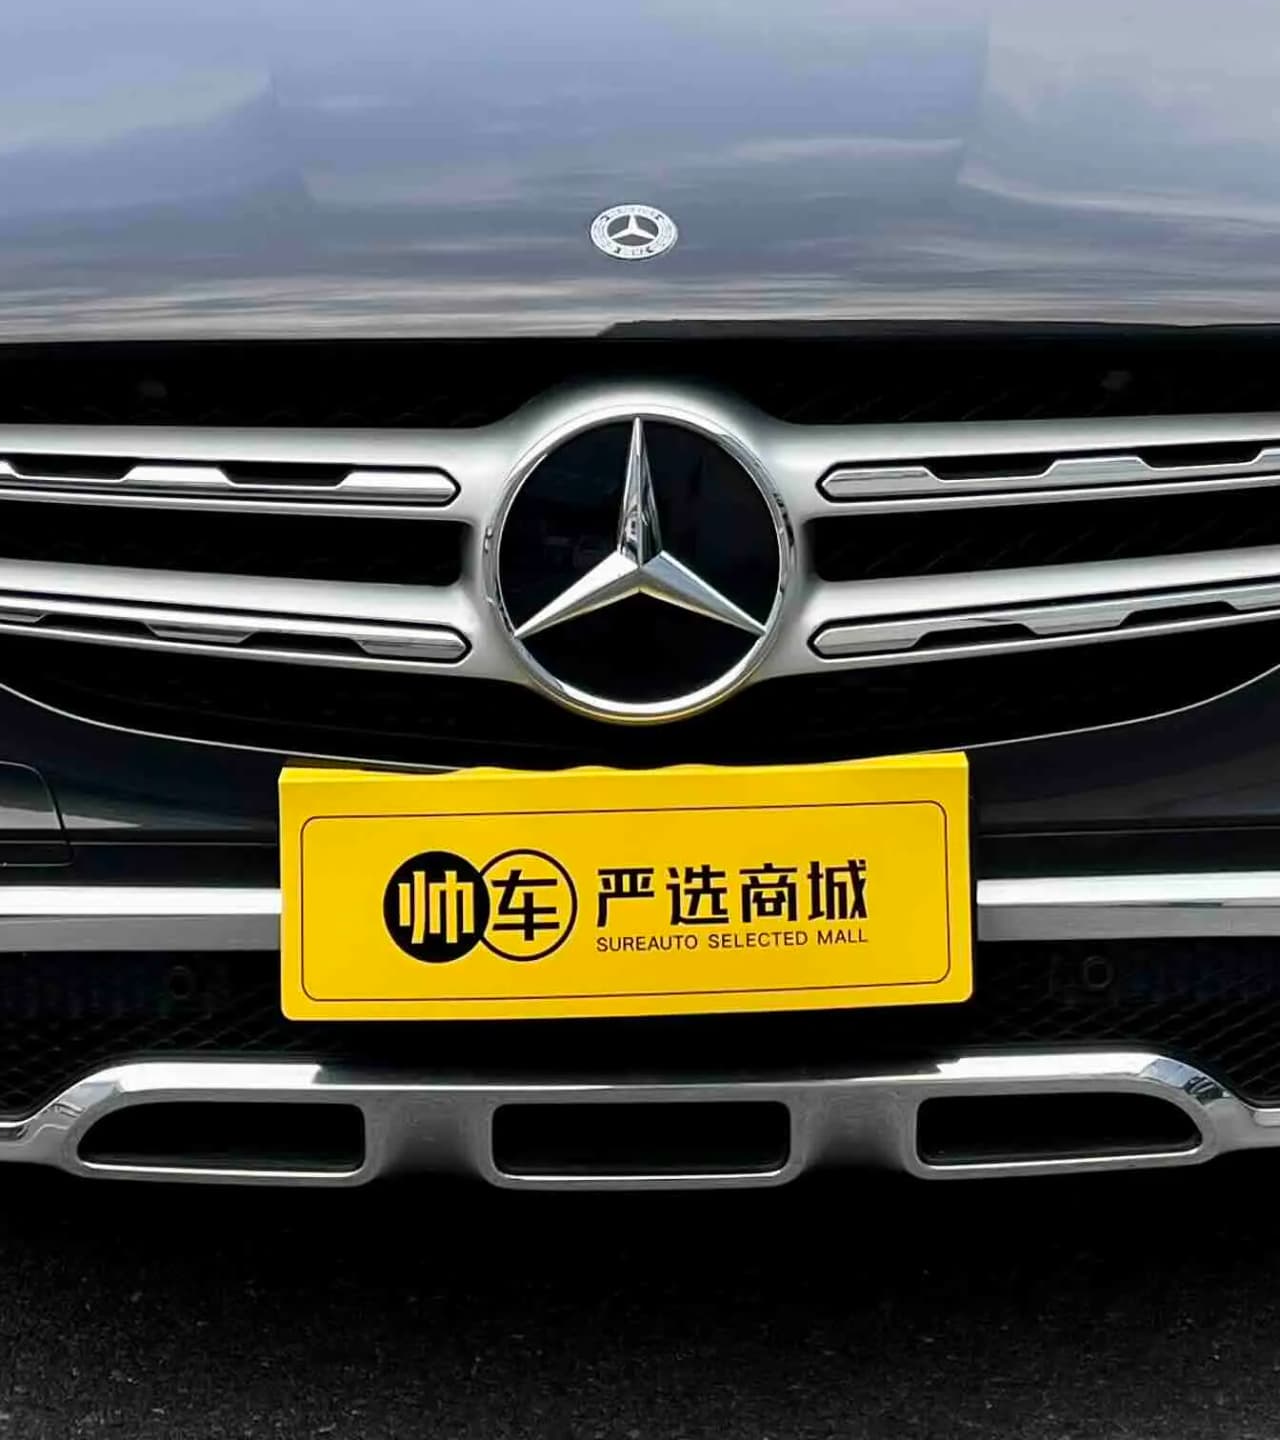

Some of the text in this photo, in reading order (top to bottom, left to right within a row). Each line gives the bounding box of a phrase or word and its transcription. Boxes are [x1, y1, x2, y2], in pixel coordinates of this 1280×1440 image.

[398, 859, 868, 944] 帅车 严选商城
[596, 927, 868, 953] SUREAUTO SELECTED MALL
